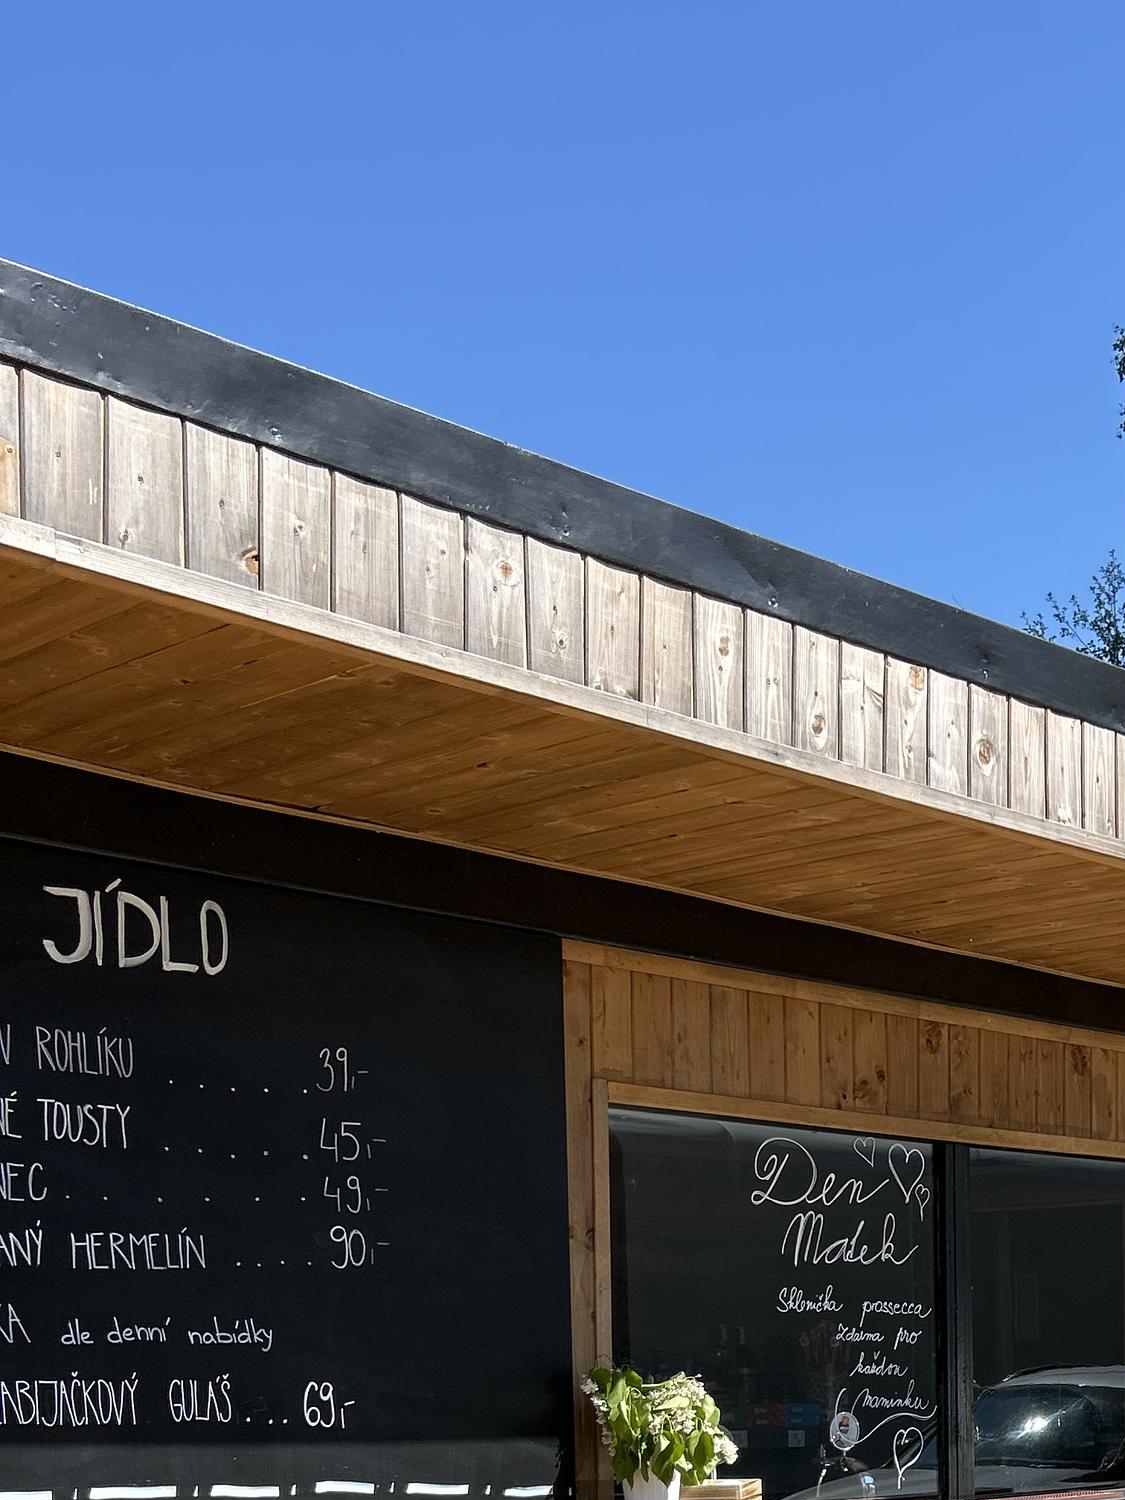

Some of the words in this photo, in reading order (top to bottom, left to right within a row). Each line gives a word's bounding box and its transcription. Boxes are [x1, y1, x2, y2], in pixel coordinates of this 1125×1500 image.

[43, 878, 228, 976] JÍDLO
[36, 1027, 133, 1078] ROHLÍKU
[37, 1098, 130, 1149] TOUSTY
[751, 1137, 890, 1207] Den
[70, 1227, 206, 1269] HERMELÍN
[780, 1210, 918, 1267] Matek
[61, 1318, 94, 1345] dle
[107, 1316, 171, 1344] denní
[188, 1316, 273, 1352] nabídky
[894, 1327, 922, 1350] pro
[0, 1371, 138, 1427] ABIJAČKOVÝ
[169, 1373, 233, 1424] GULÁŠ
